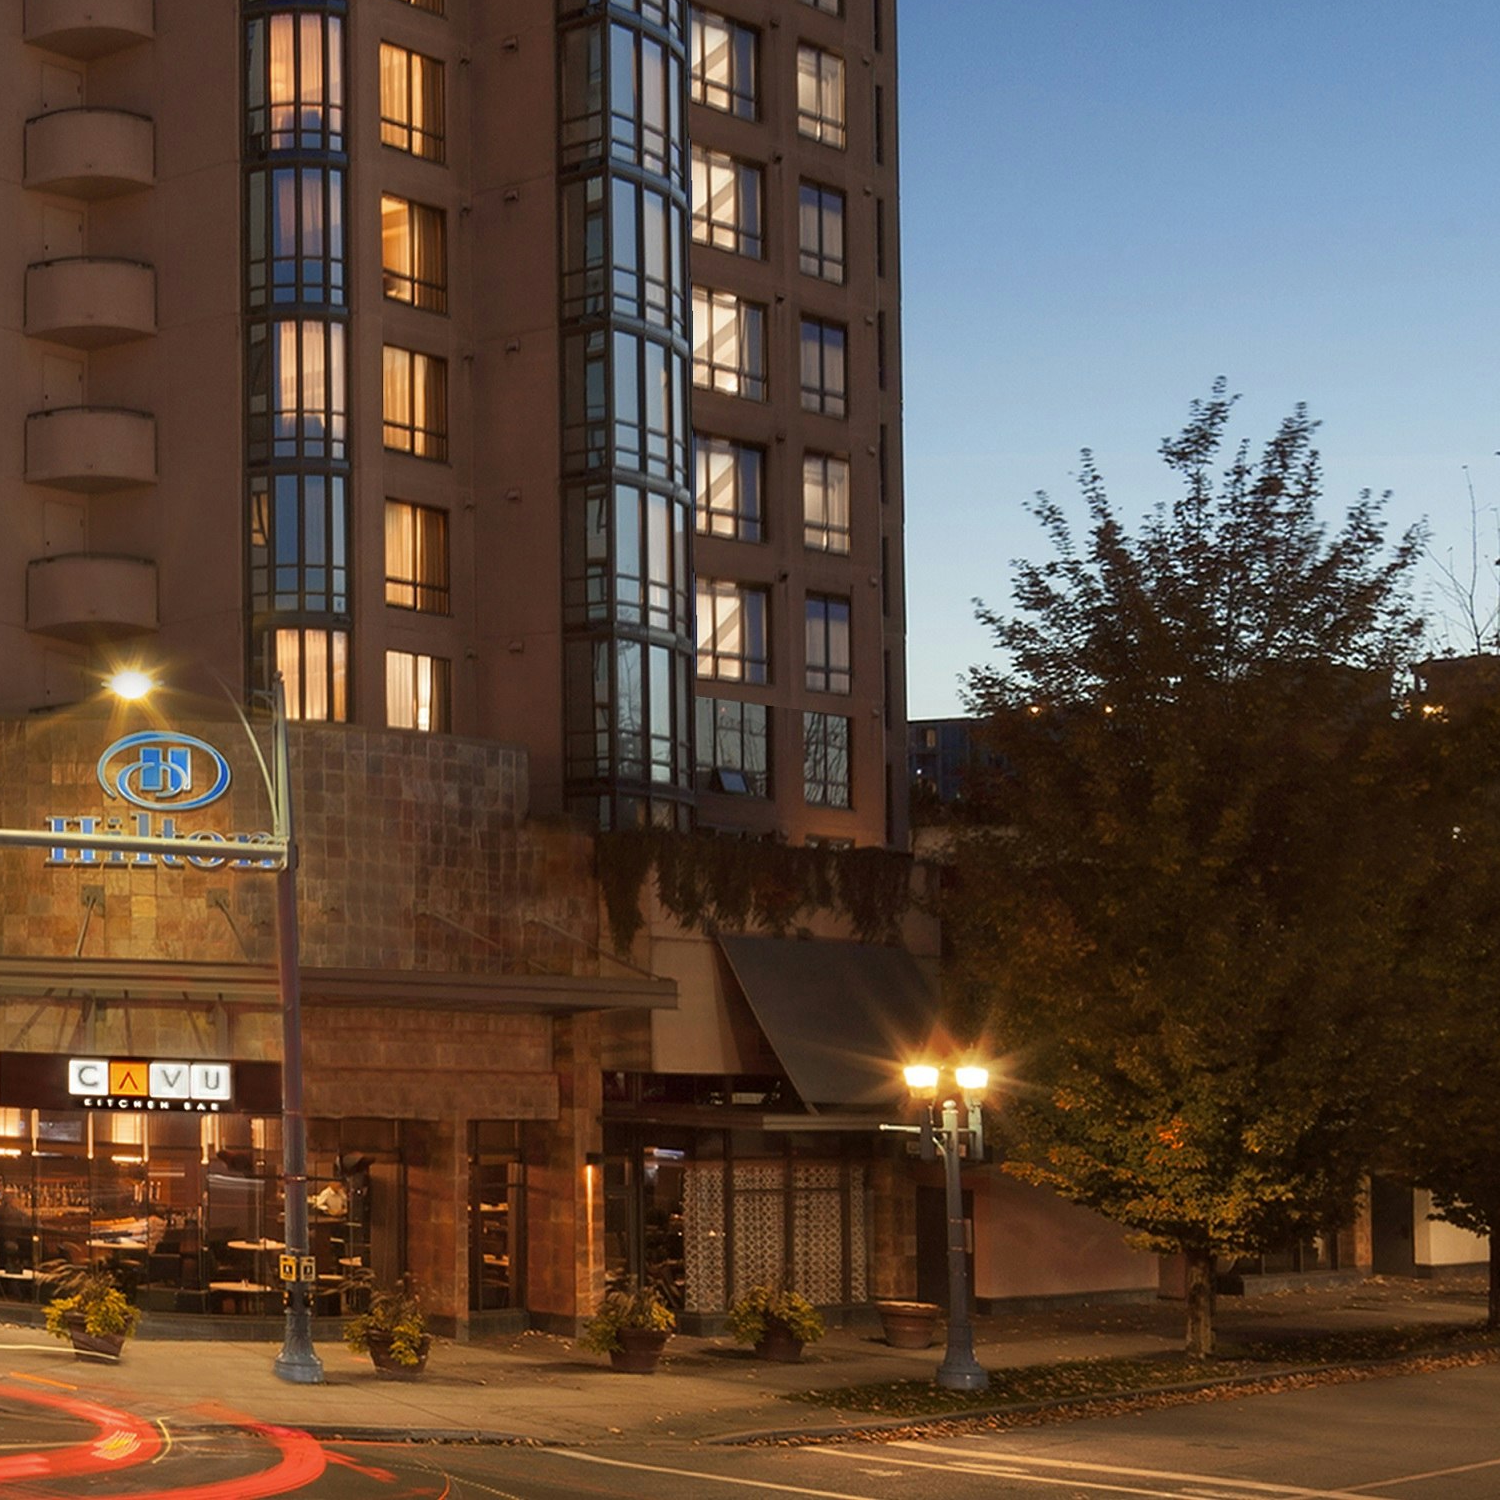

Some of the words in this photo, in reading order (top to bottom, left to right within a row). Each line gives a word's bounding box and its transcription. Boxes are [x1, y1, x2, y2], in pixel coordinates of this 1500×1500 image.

[77, 1066, 220, 1090] CAVU
[83, 1098, 170, 1110] KITCHEN
[183, 1102, 220, 1112] BAR
